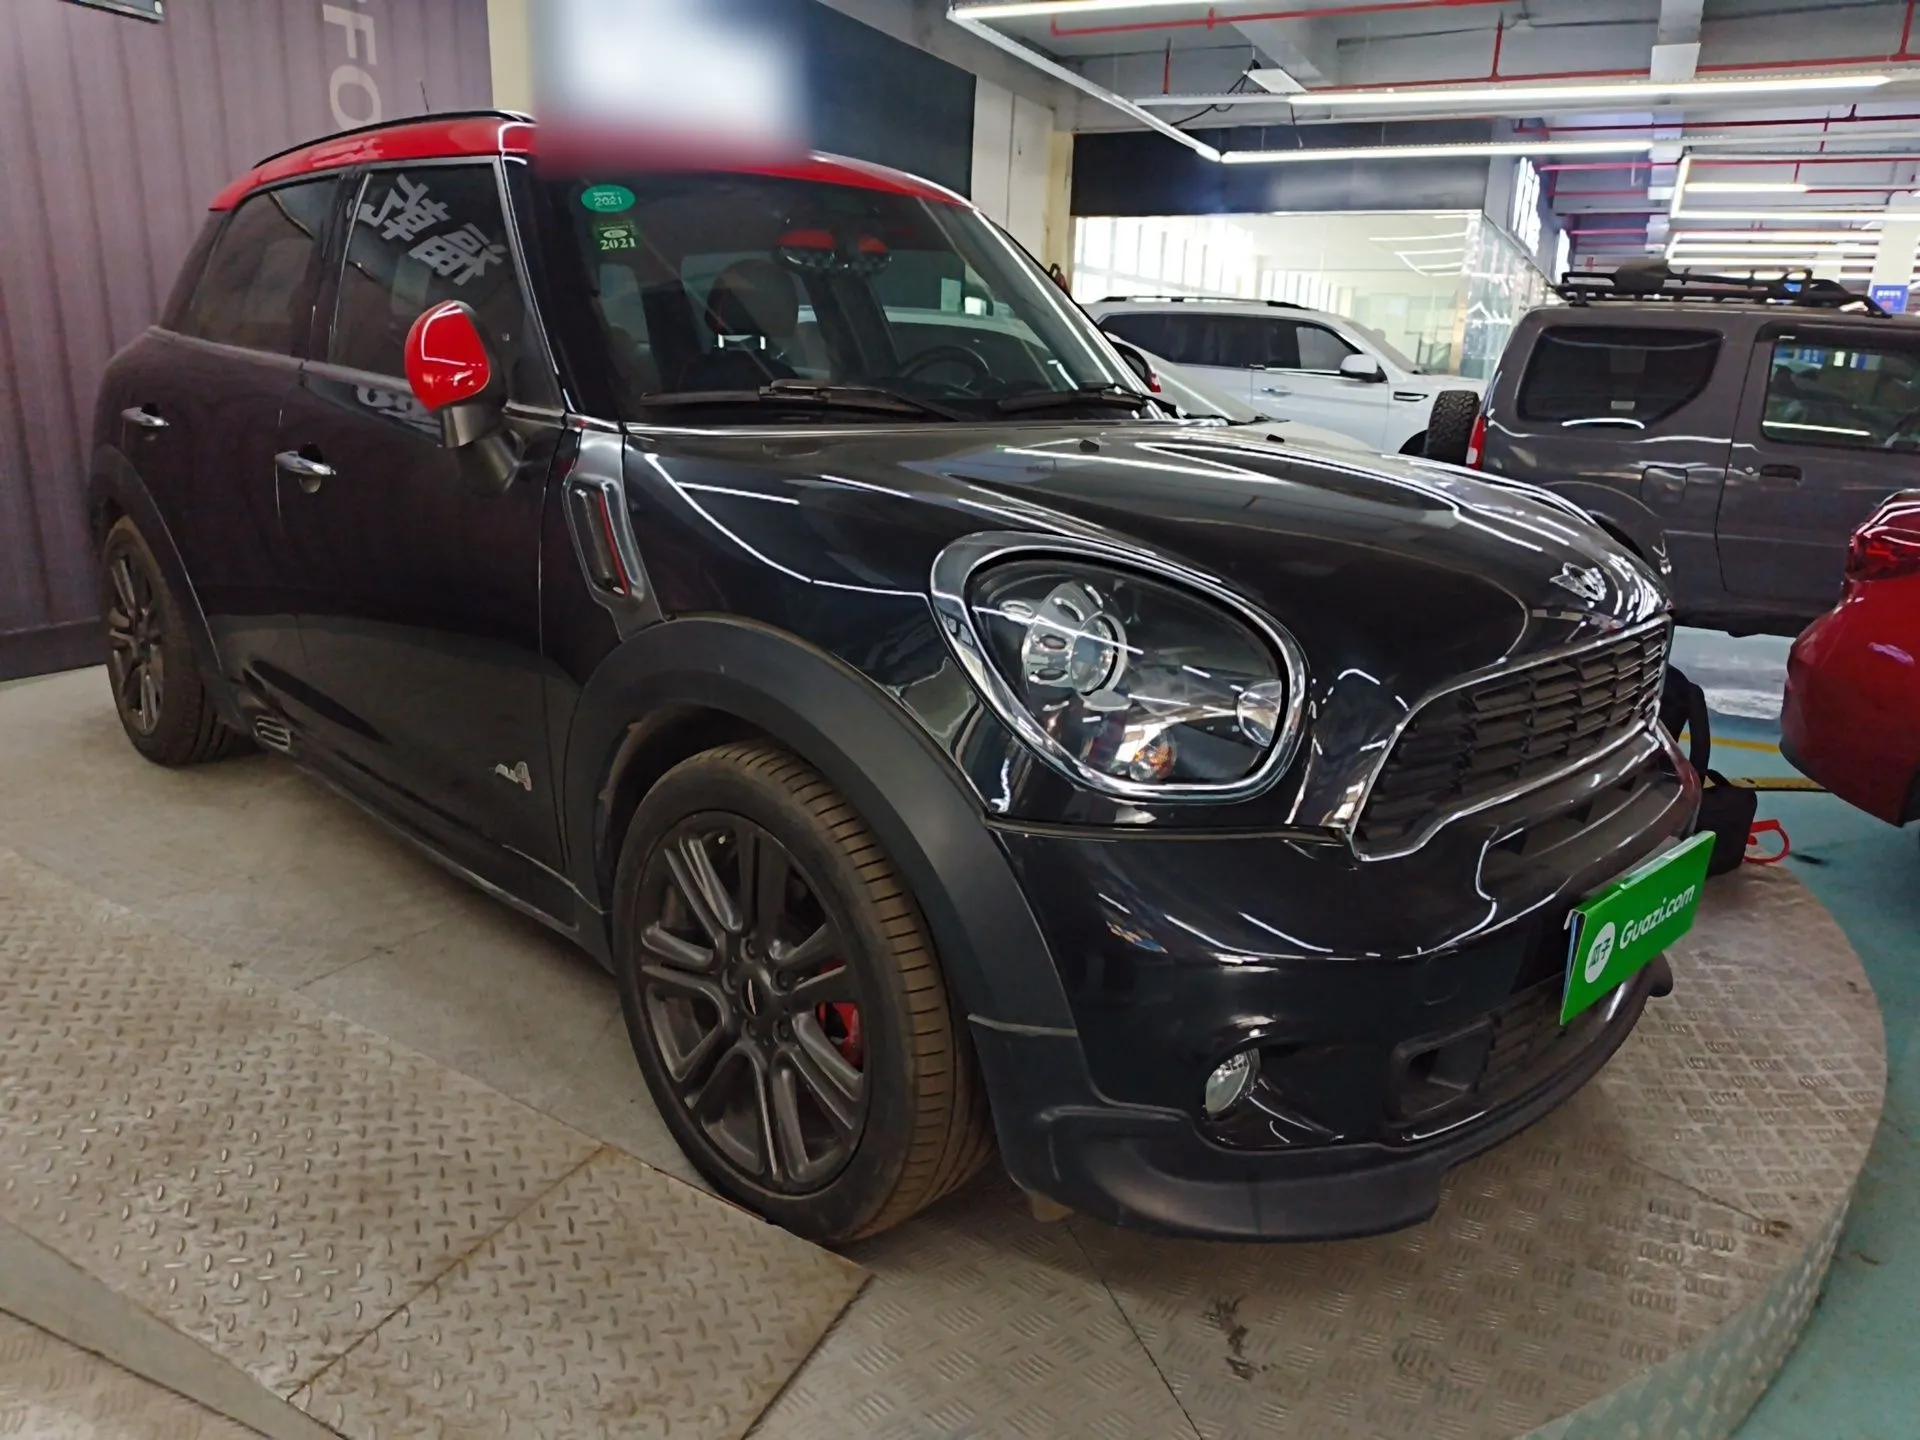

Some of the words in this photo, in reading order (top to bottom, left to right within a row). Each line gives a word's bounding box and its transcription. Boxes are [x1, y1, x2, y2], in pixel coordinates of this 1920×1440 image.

[322, 0, 382, 130] FO
[594, 196, 623, 206] 2021
[600, 237, 636, 250] 2021
[1620, 884, 1696, 949] Guazi.com
